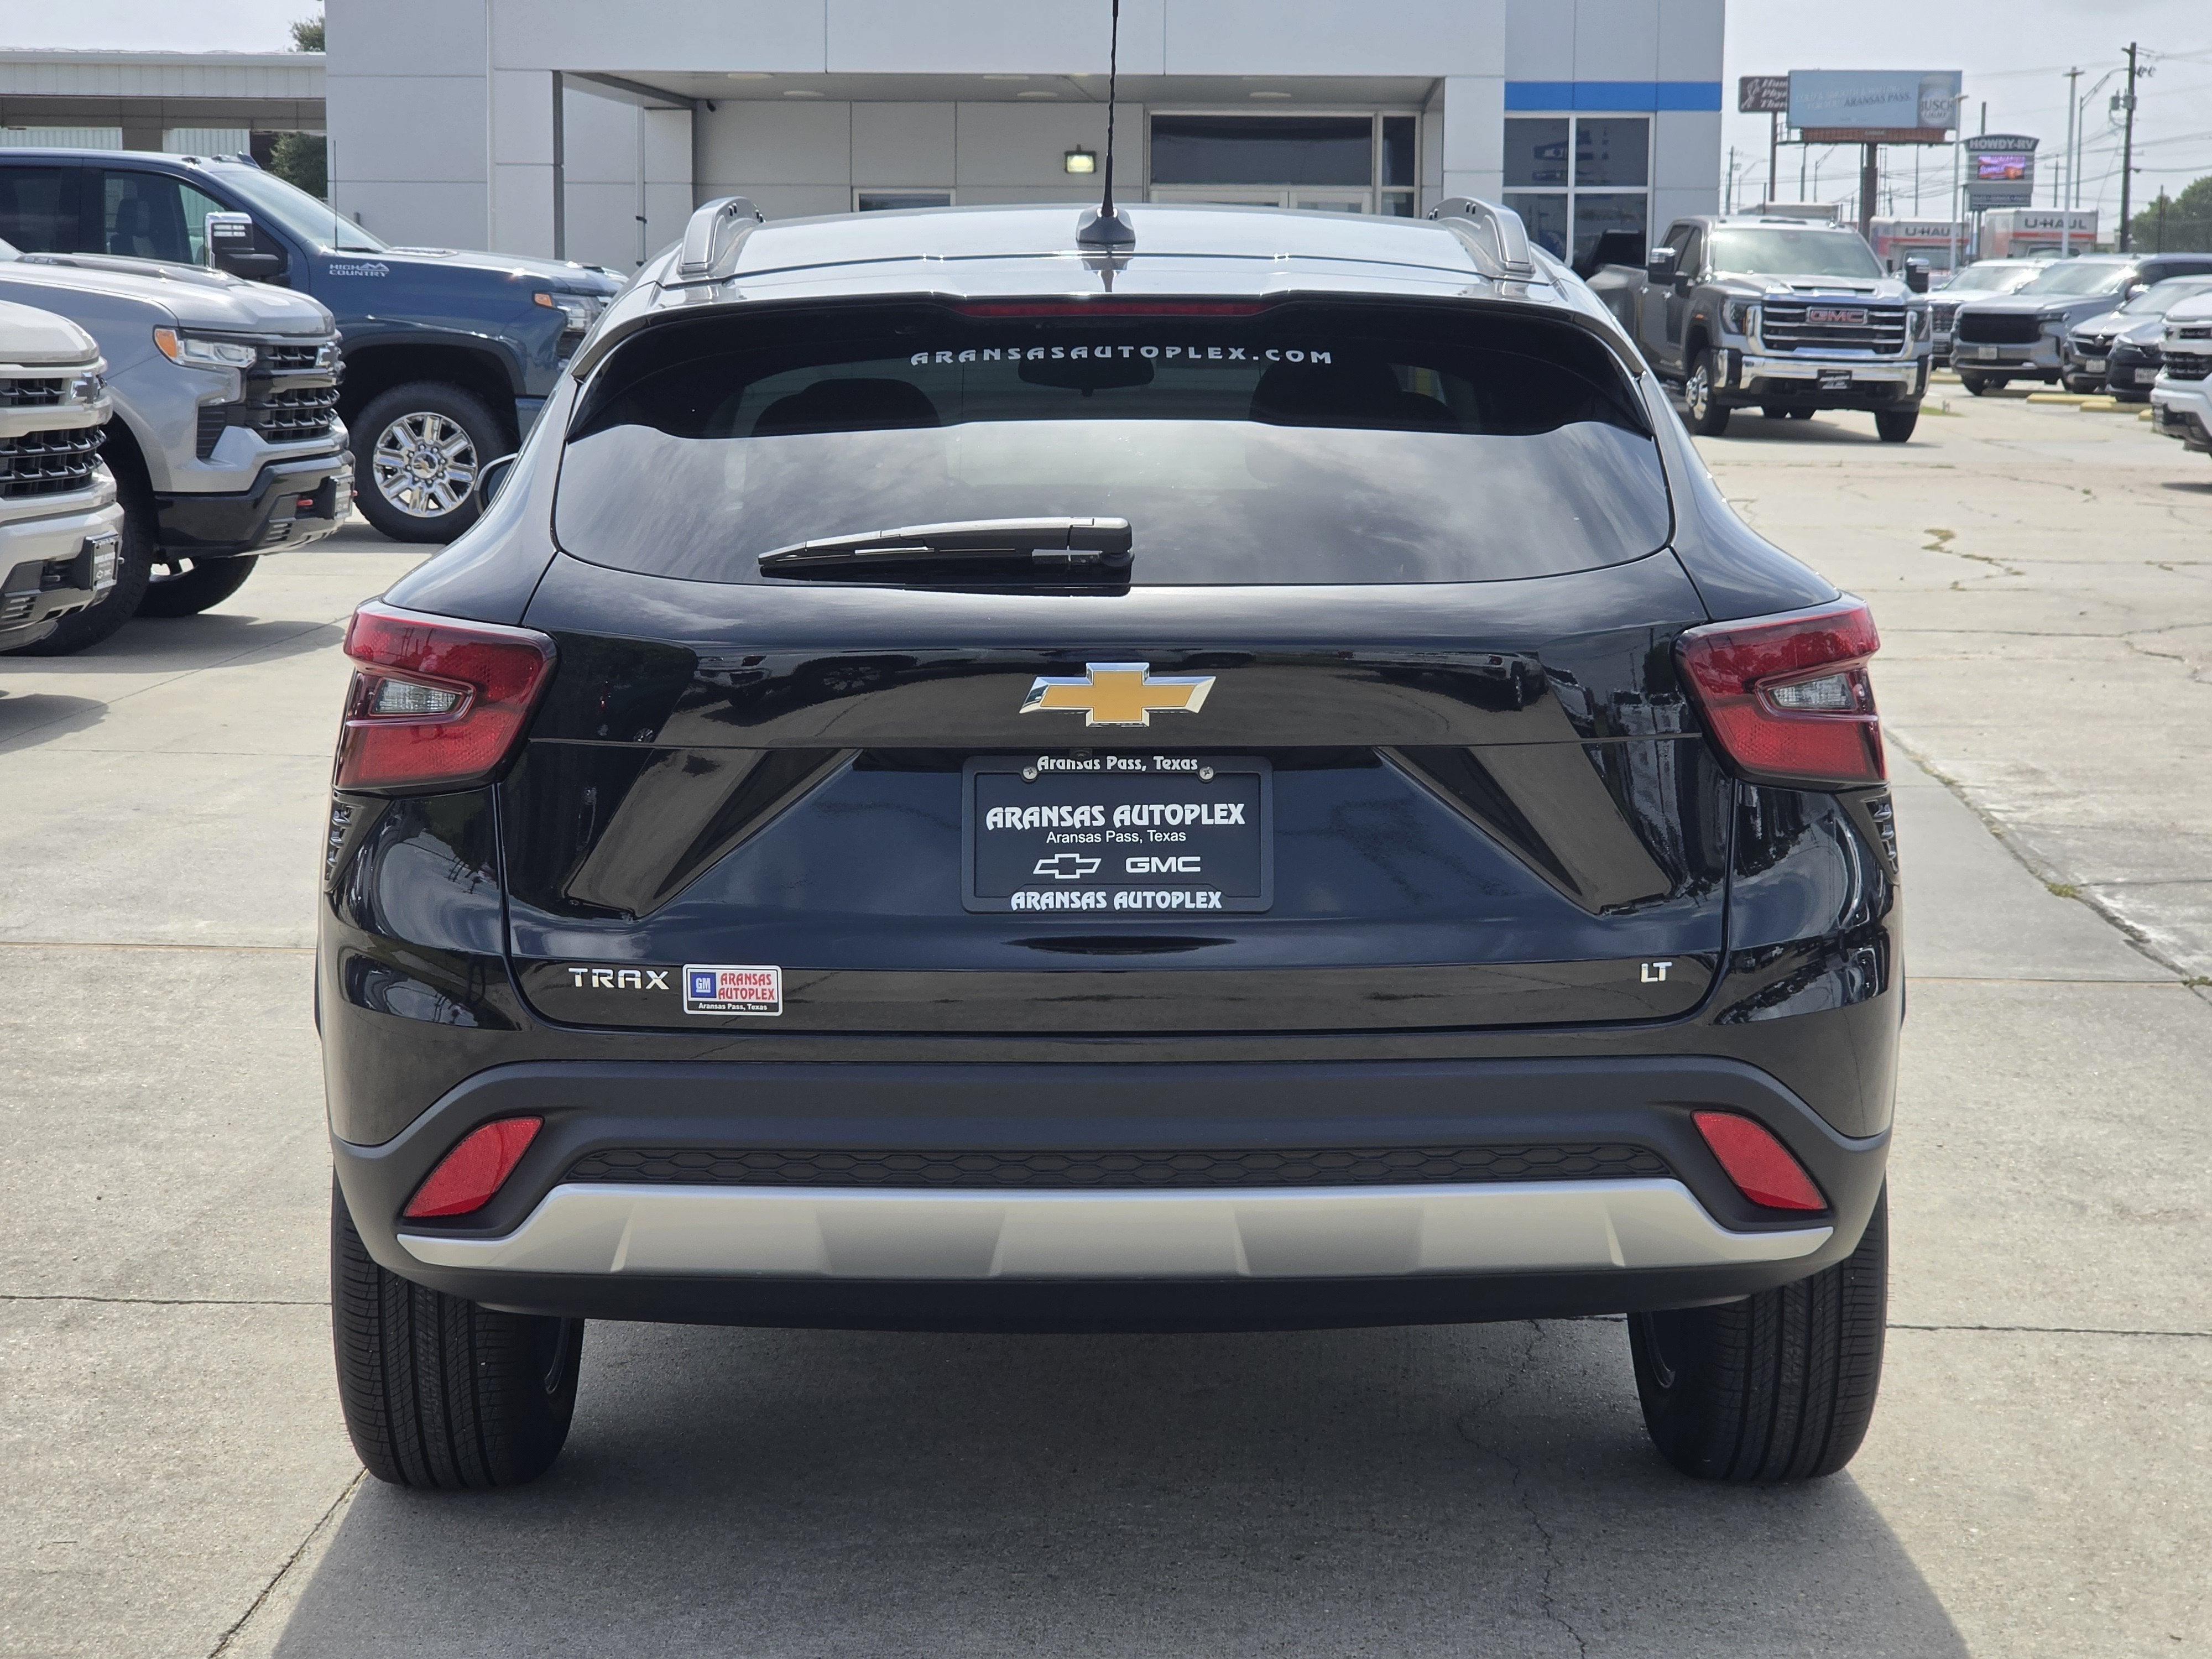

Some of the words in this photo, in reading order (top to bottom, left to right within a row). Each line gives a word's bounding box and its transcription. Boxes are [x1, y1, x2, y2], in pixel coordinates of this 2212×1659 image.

[2025, 218, 2087, 229] U-HAUL
[1905, 227, 1959, 237] U-HAU
[1810, 310, 1864, 323] GMC
[910, 346, 1332, 366] ARANSASAUTOPLEX.COM
[1037, 755, 1100, 771] Aransas
[1106, 755, 1147, 771] Pass,
[1153, 755, 1198, 770] Texas
[986, 804, 1105, 831] ARANSAS
[1113, 803, 1245, 828] AUTOPLEX
[1046, 831, 1102, 843] Aransas
[1106, 830, 1143, 844] Pass,
[1146, 830, 1186, 842] Texas
[1125, 856, 1201, 873] GMC
[1010, 891, 1107, 911] ARANSAS
[1113, 891, 1222, 910] AUTOPLEX
[568, 968, 670, 990] TRAX
[720, 973, 772, 987] ARANSAS
[1641, 962, 1672, 983] LT
[696, 978, 711, 990] GM
[718, 987, 775, 1000] AUTOPLEX
